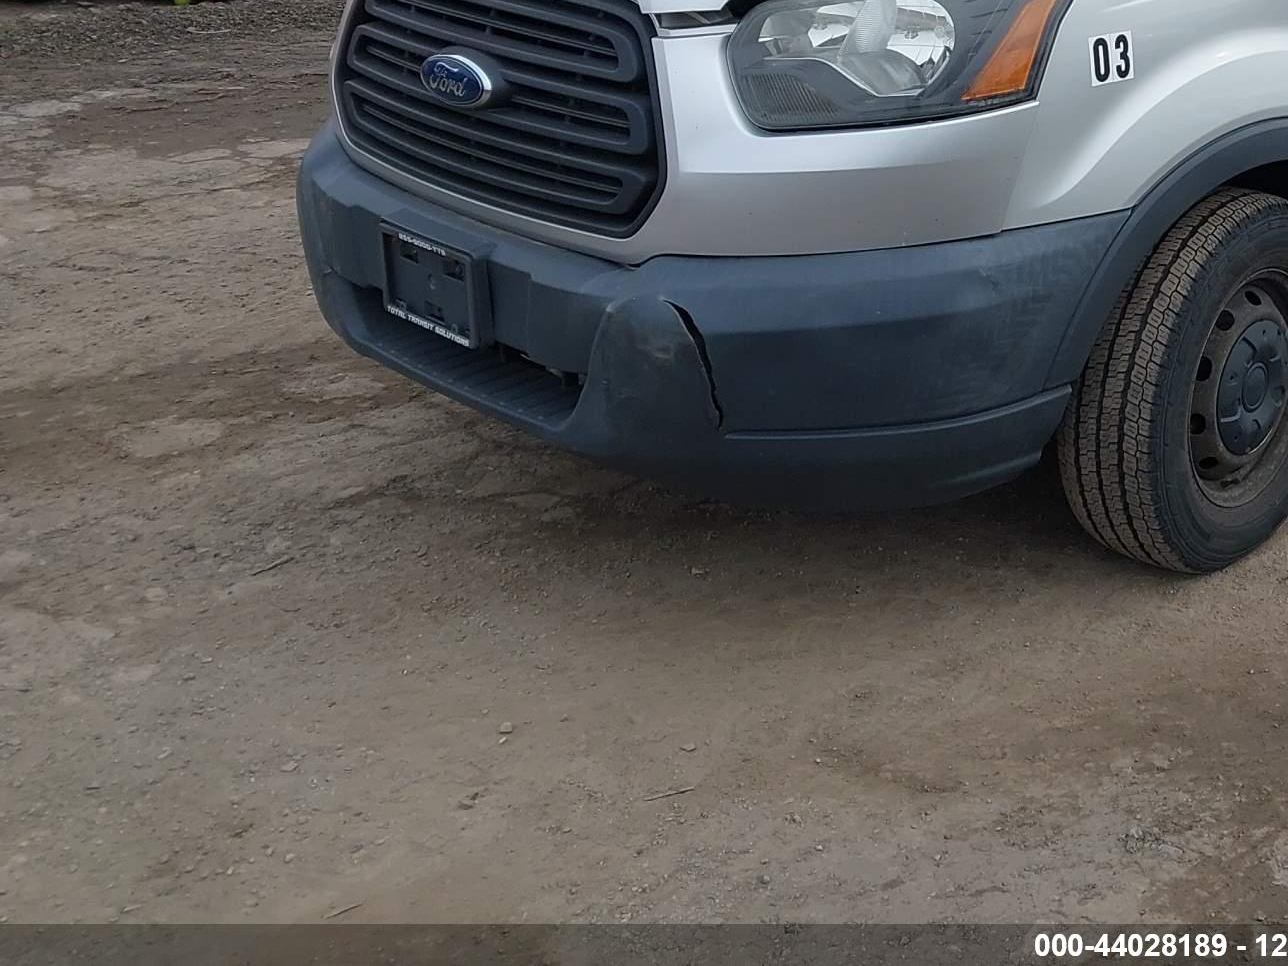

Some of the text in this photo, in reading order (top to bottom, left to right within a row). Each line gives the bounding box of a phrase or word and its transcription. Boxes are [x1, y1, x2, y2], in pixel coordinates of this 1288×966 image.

[429, 61, 469, 97] Ford
[1093, 34, 1131, 82] 03
[386, 305, 470, 347] TOTAL TRANSIT SOLUTIONS
